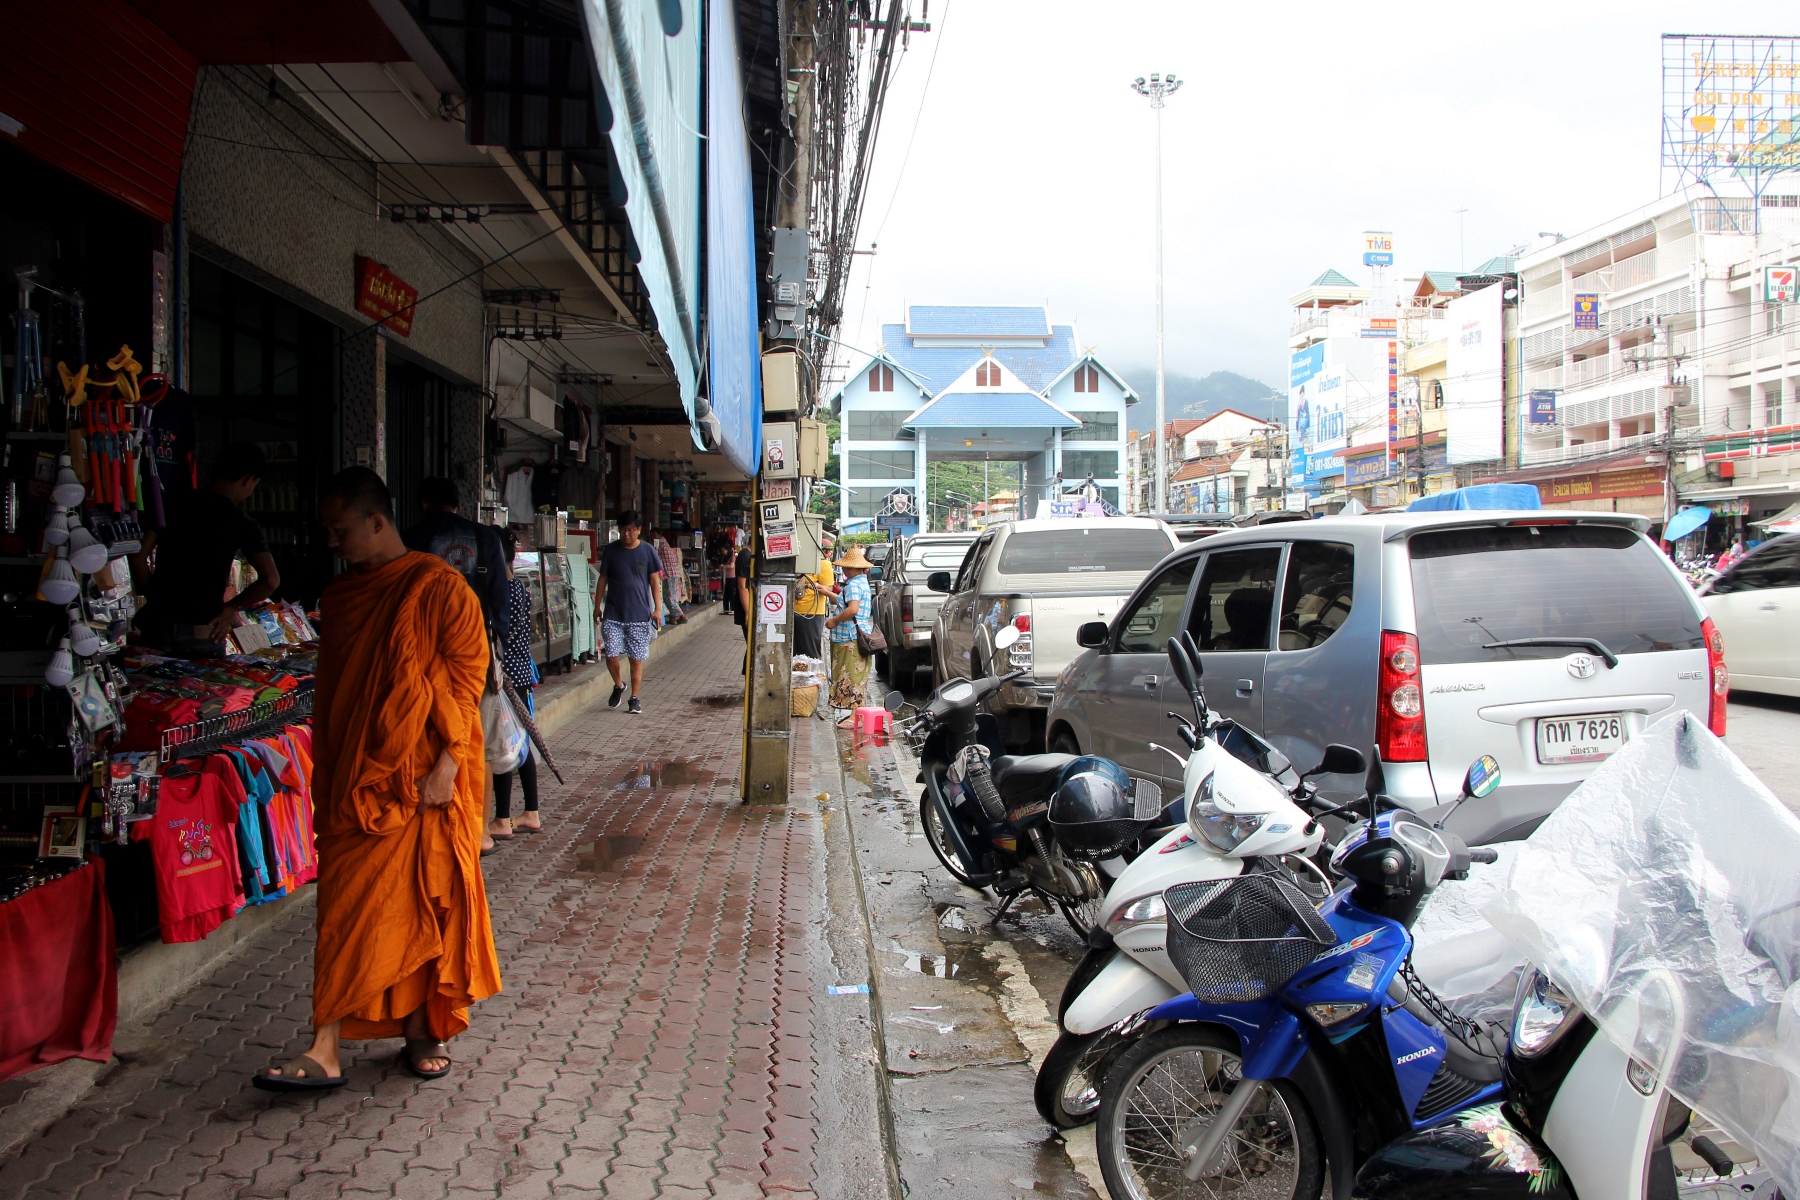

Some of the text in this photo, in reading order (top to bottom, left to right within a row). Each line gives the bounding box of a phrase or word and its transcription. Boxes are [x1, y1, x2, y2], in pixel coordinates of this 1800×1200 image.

[1691, 52, 1757, 77] โรงแรม
[1693, 92, 1764, 105] GOLDEN
[1366, 237, 1392, 250] TMB
[1429, 683, 1485, 694] AVANZA
[1545, 719, 1619, 743] กท 7626
[1216, 791, 1236, 808] HONDA
[1396, 1045, 1436, 1065] HONDA
